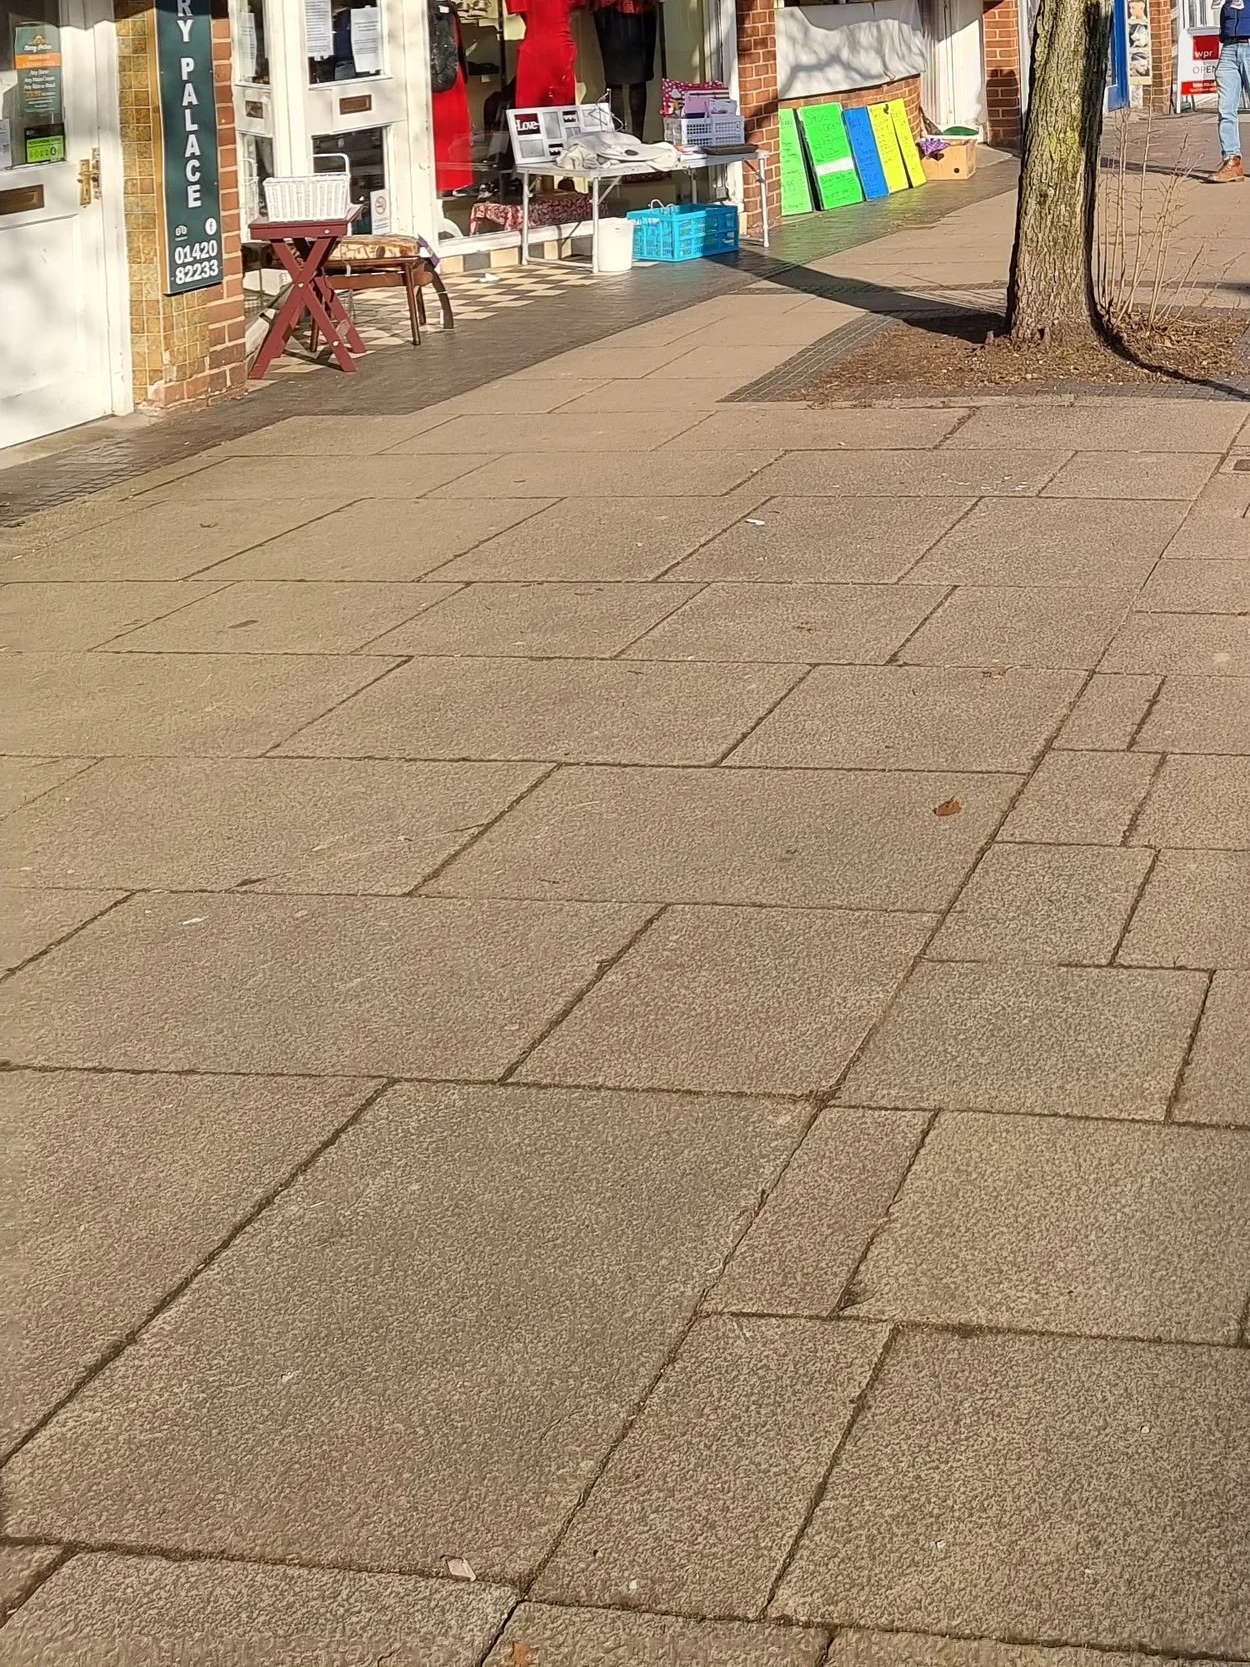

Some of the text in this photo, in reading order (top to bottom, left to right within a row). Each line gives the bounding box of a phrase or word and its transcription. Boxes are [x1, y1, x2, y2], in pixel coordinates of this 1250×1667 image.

[1194, 50, 1214, 59] wpr
[180, 57, 203, 209] PALACE
[515, 119, 541, 132] Love
[174, 239, 218, 265] 01420
[174, 260, 219, 286] 82233
